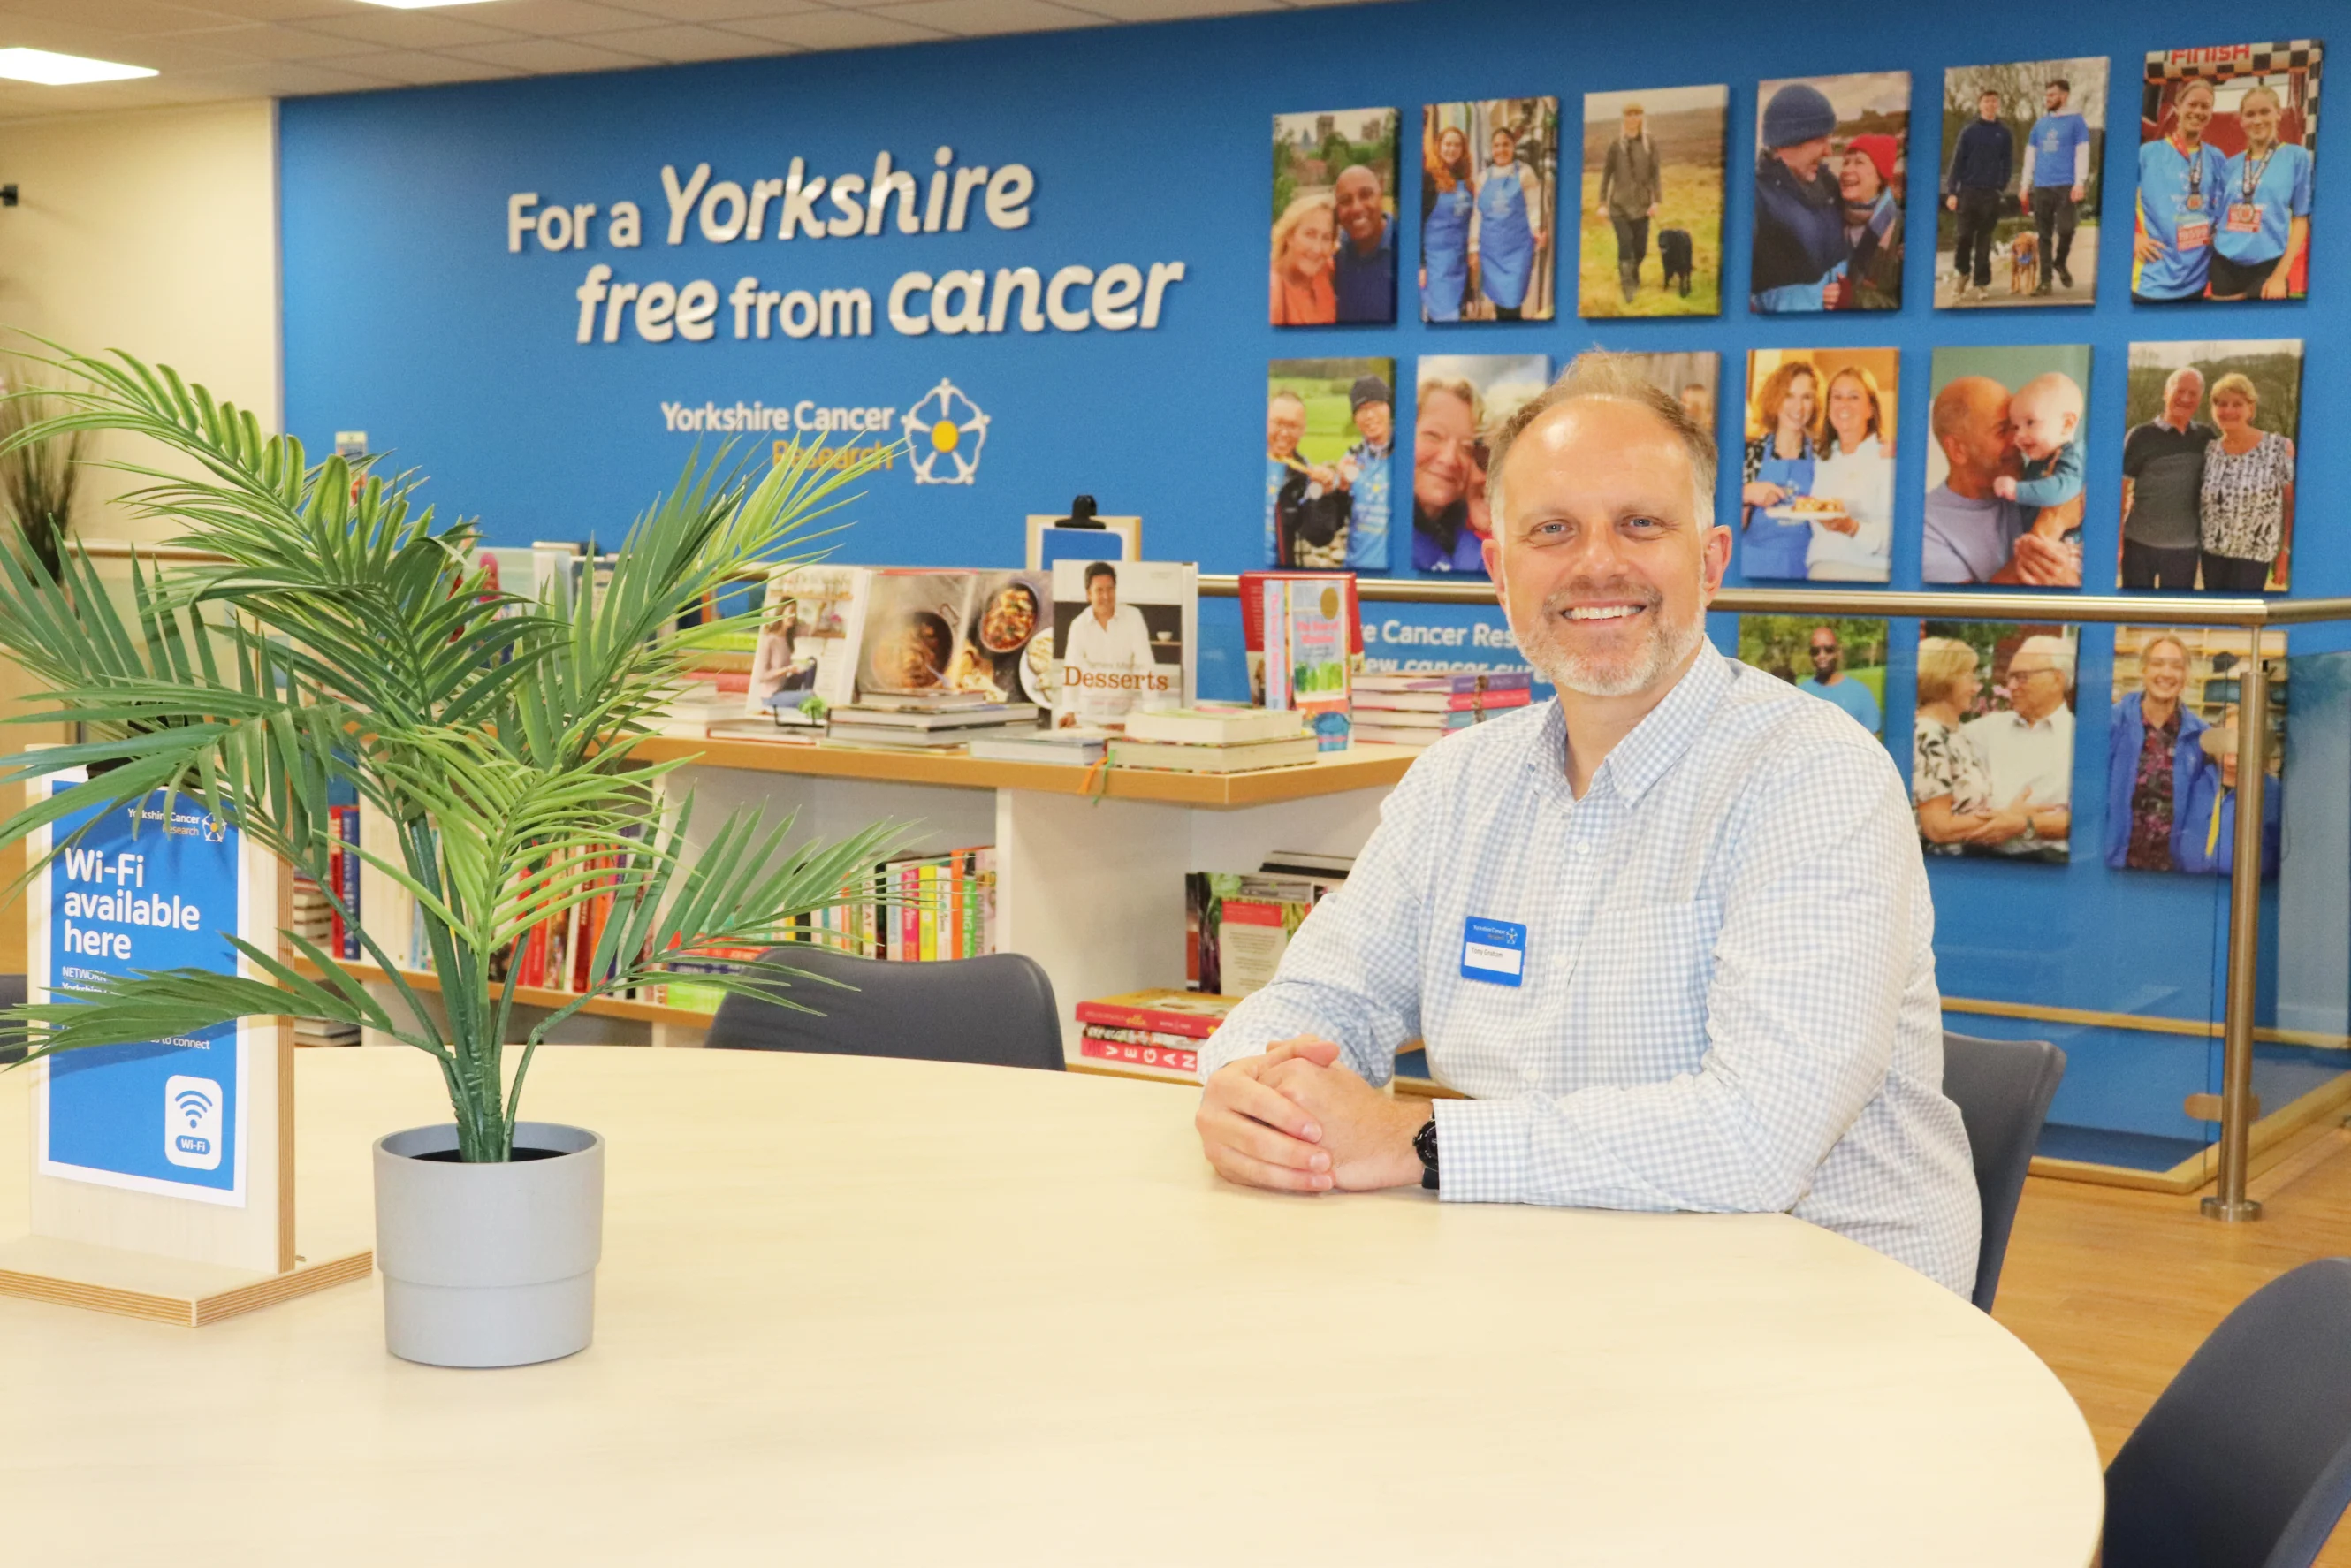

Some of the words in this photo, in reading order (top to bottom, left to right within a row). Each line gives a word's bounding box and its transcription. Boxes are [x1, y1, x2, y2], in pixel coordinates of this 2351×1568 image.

[507, 193, 597, 254] For
[609, 201, 641, 248] a
[660, 145, 1035, 246] Yorkshire
[575, 264, 718, 344] free
[730, 277, 873, 340] from
[888, 261, 1185, 337] cancer
[661, 400, 789, 431] Yorkshire
[794, 400, 895, 431] Cancer
[1383, 620, 1467, 646] Cancer
[1473, 622, 1517, 648] Res
[1063, 666, 1169, 691] Desserts
[127, 808, 166, 821] Yokshir
[170, 812, 201, 824] Cancer
[65, 847, 144, 887] Wi-Fi
[65, 889, 200, 931] available
[65, 919, 132, 959] here
[173, 1038, 211, 1050] connect
[1106, 1045, 1196, 1069] VEGAN
[180, 1138, 206, 1152] Wi-Fi
